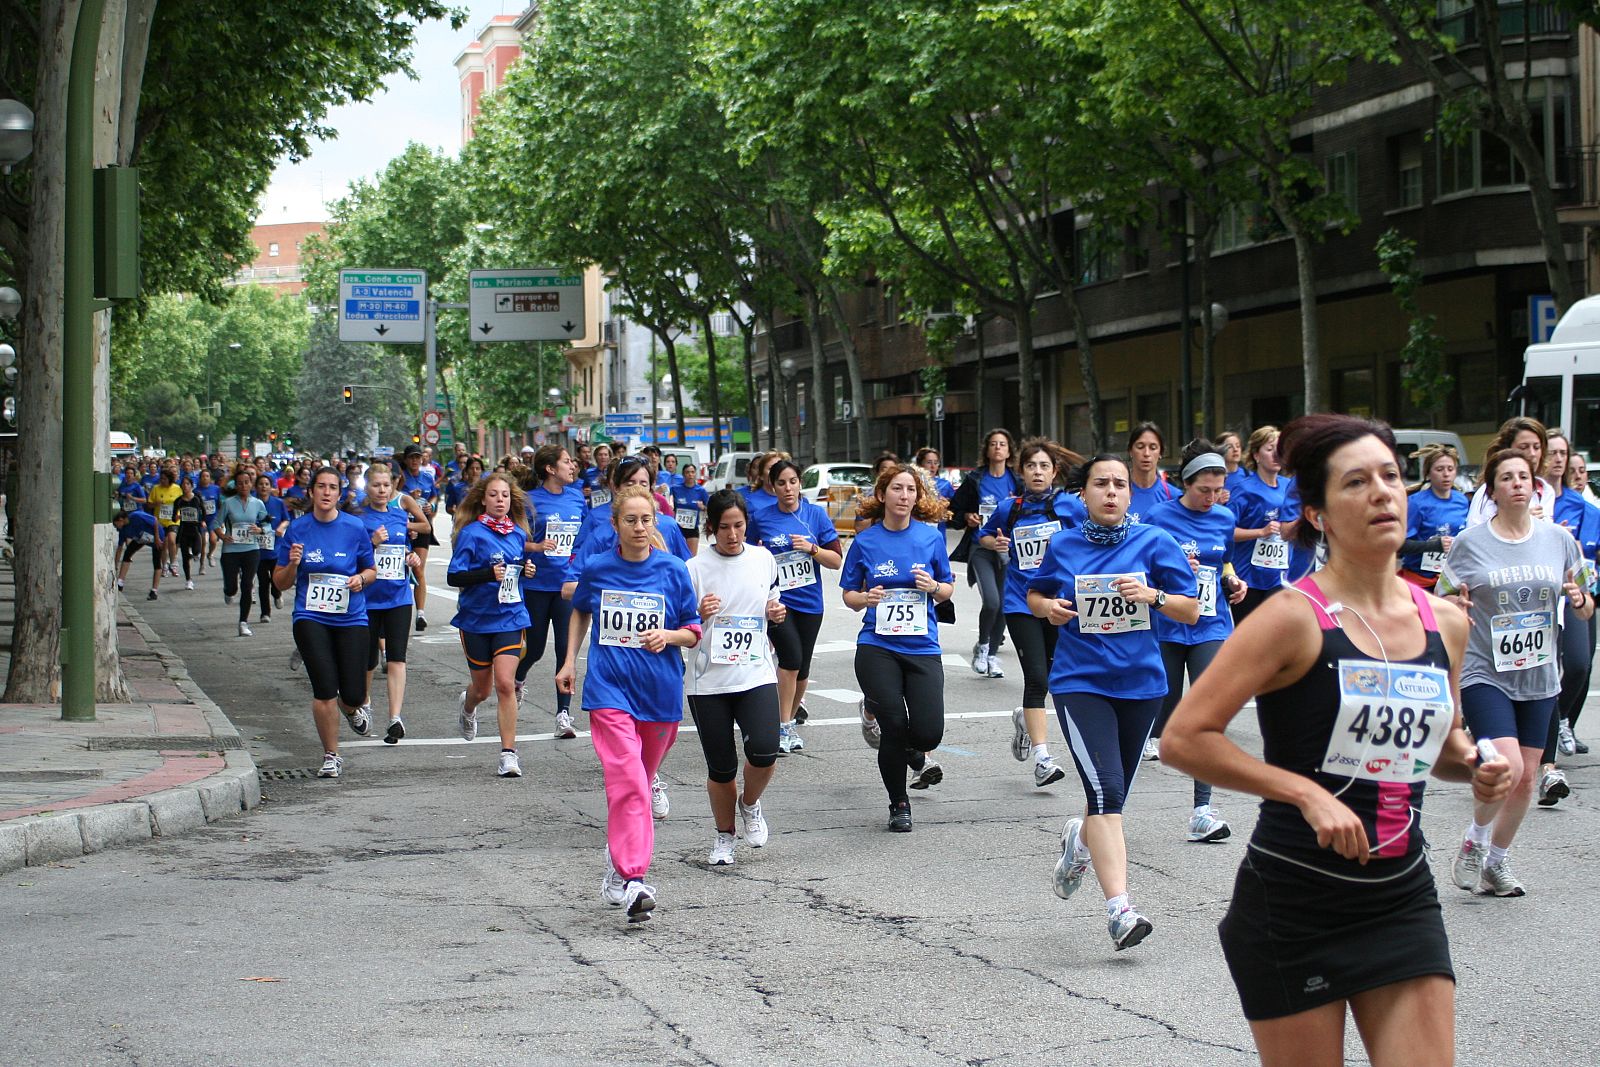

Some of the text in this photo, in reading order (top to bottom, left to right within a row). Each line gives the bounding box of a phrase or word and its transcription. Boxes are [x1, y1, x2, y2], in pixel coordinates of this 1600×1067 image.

[496, 279, 533, 287] Mariano
[372, 288, 413, 297] Valencia
[515, 295, 543, 303] parque
[515, 303, 559, 312] El Retiro
[1258, 541, 1284, 558] 3005
[378, 556, 402, 570] 4917
[781, 560, 811, 580] 1130
[1487, 564, 1557, 589] REEBOK
[311, 586, 343, 602] 5125
[886, 604, 914, 622] 755
[1084, 596, 1138, 618] 7288
[603, 610, 659, 632] 10188
[722, 631, 752, 650] 399
[1500, 629, 1544, 655] 6640
[1347, 704, 1436, 749] 4385
